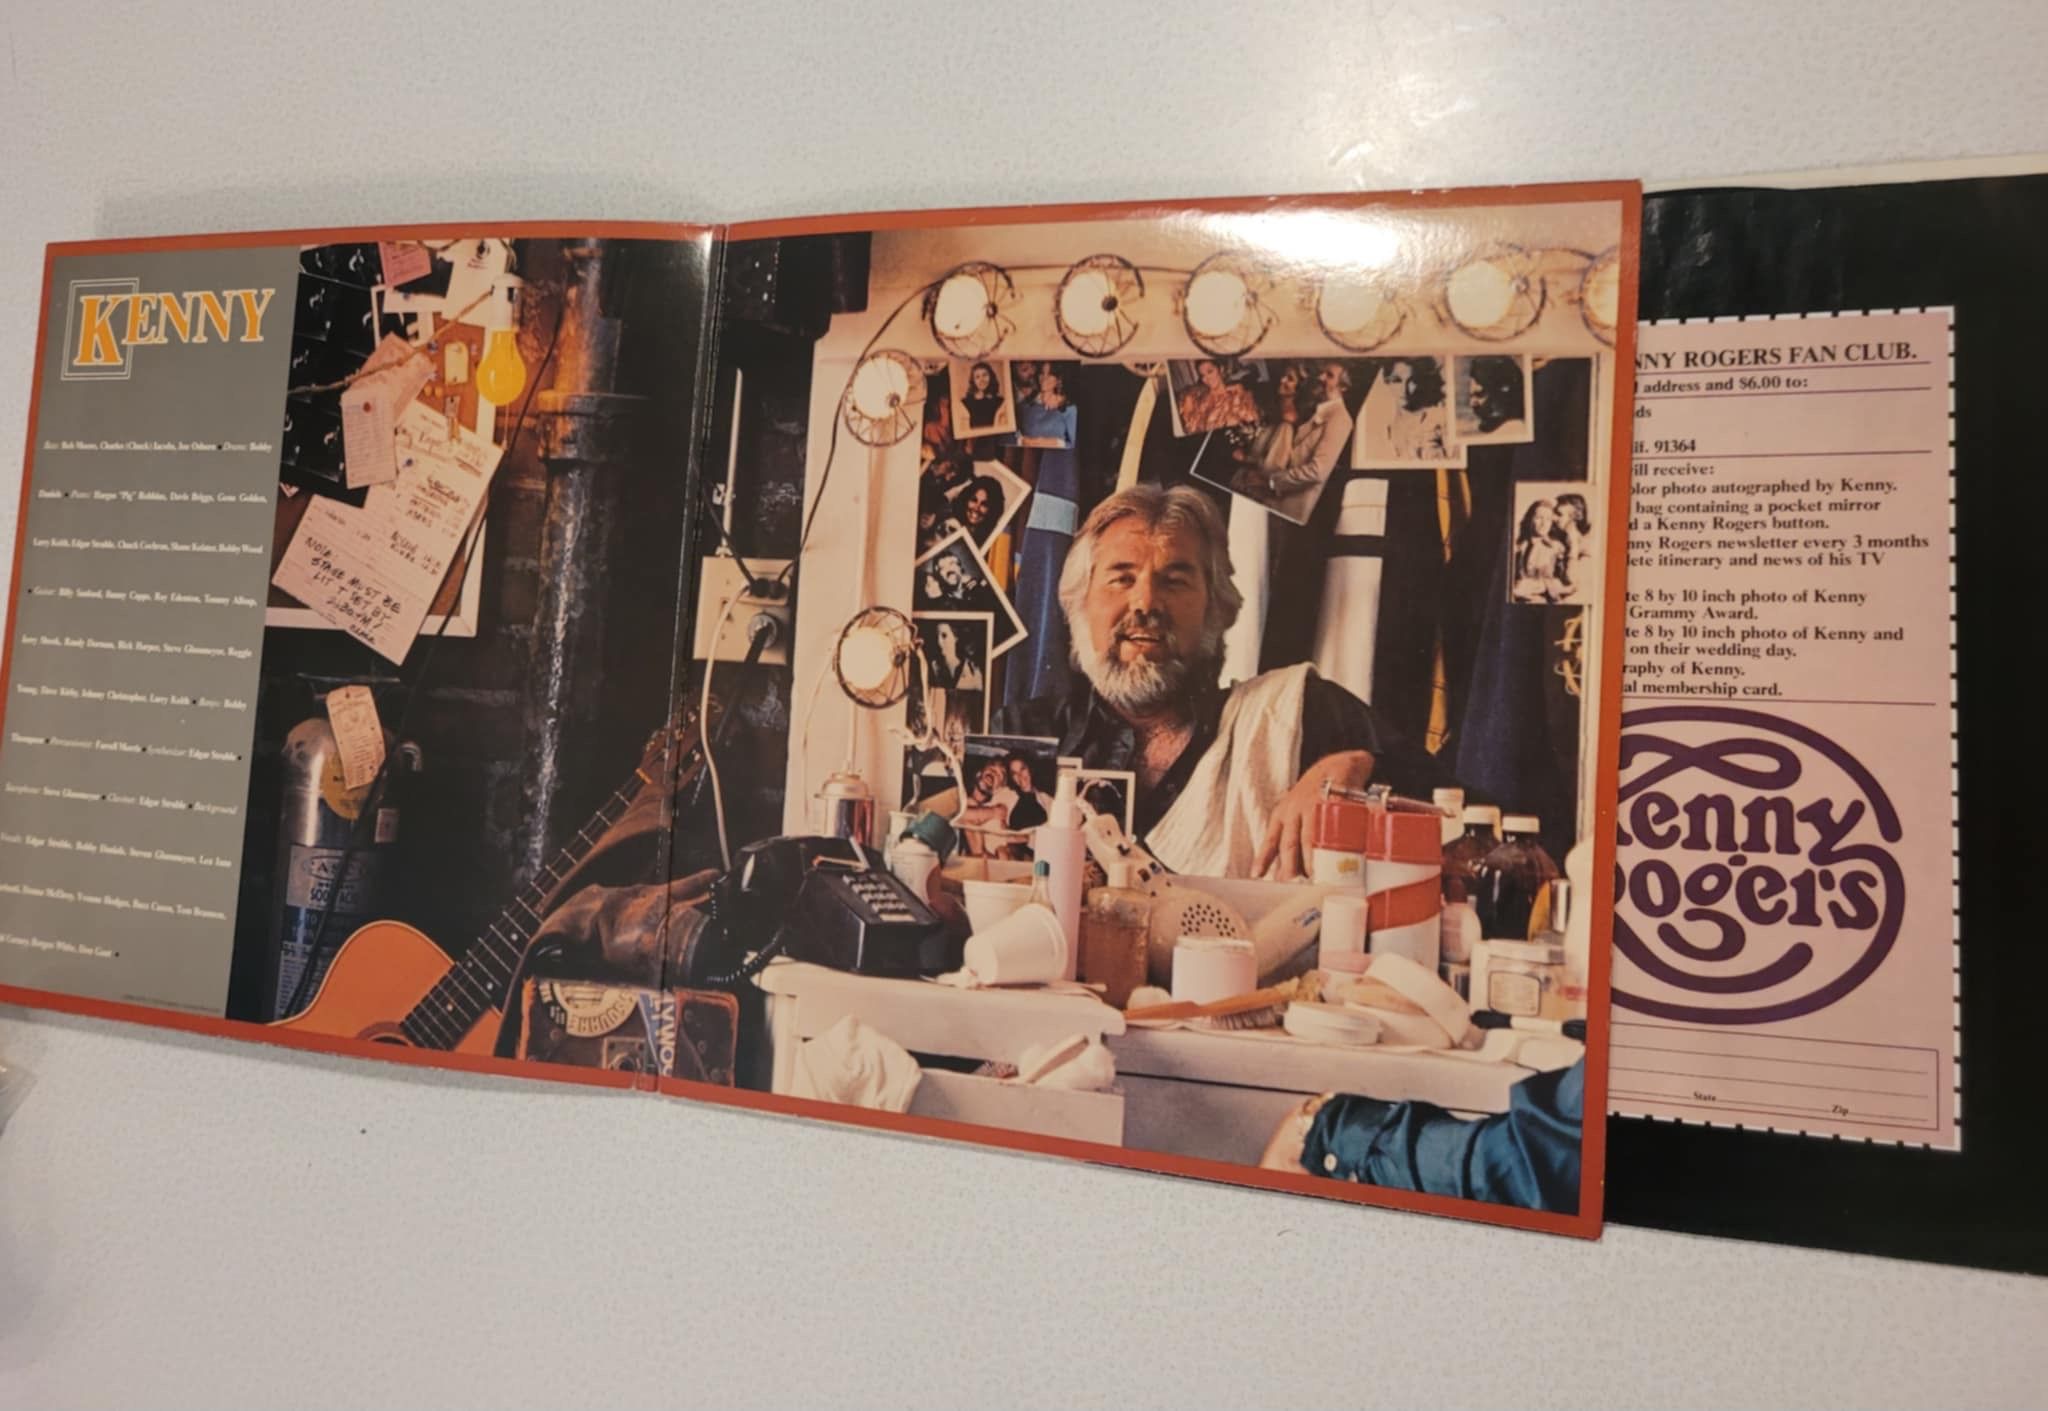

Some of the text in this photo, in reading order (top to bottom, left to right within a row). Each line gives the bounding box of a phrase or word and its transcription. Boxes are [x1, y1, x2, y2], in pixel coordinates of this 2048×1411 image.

[73, 288, 276, 366] KENNY
[1684, 347, 1782, 368] ROGERS
[1789, 345, 1837, 365] FAN
[1844, 341, 1918, 362] CLUB.
[1643, 380, 1700, 393] address
[1705, 377, 1735, 391] and
[1739, 375, 1781, 390] $6.00
[1786, 375, 1808, 388] to:
[1654, 439, 1696, 453] 91364
[1632, 462, 1714, 476] ill receive:
[1662, 481, 1706, 498] photo
[1712, 479, 1810, 496] autographed
[1816, 478, 1834, 495] by
[1841, 477, 1897, 494] Kenny.
[1636, 501, 1663, 515] bag
[1667, 500, 1749, 515] containing
[1768, 500, 1822, 515] pocket
[1828, 499, 1881, 512] mirror
[1643, 522, 1652, 530] a
[1657, 517, 1705, 533] Kenny
[1712, 516, 1767, 532] Rogers
[1772, 517, 1830, 529] button.
[1659, 536, 1712, 552] Rogers
[1717, 536, 1799, 549] newsletter
[1803, 539, 1848, 552] every
[1853, 534, 1863, 548] 3
[1867, 534, 1930, 548] months
[1658, 553, 1722, 570] itinerary
[1729, 553, 1758, 566] and
[1763, 556, 1802, 566] news
[1807, 553, 1825, 566] of
[1829, 553, 1852, 566] his
[1857, 551, 1886, 566] TV
[1644, 588, 1654, 602] 8
[1658, 588, 1677, 605] by
[1682, 589, 1698, 602] 10
[1702, 589, 1736, 602] inch
[1741, 590, 1787, 608] photo
[1792, 590, 1809, 603] of
[1814, 589, 1868, 606] Kenny
[1629, 605, 1758, 622] Grammy Award.
[1644, 624, 1654, 638] 8
[1658, 625, 1676, 641] by
[1682, 625, 1698, 638] 10
[1702, 625, 1735, 639] inch
[1741, 626, 1787, 643] photo
[1792, 626, 1809, 640] of
[1814, 626, 1868, 643] Kenny
[1873, 627, 1904, 641] and
[1630, 641, 1797, 660] on their wedding day.
[1671, 661, 1686, 674] of
[1692, 661, 1745, 679] Kenny.
[1642, 680, 1738, 698] membership
[1743, 682, 1783, 696] card.
[1616, 792, 1866, 866] enny
[1615, 858, 1879, 962] ogers
[1693, 1091, 1716, 1102] State
[1832, 1104, 1849, 1117] Zip
